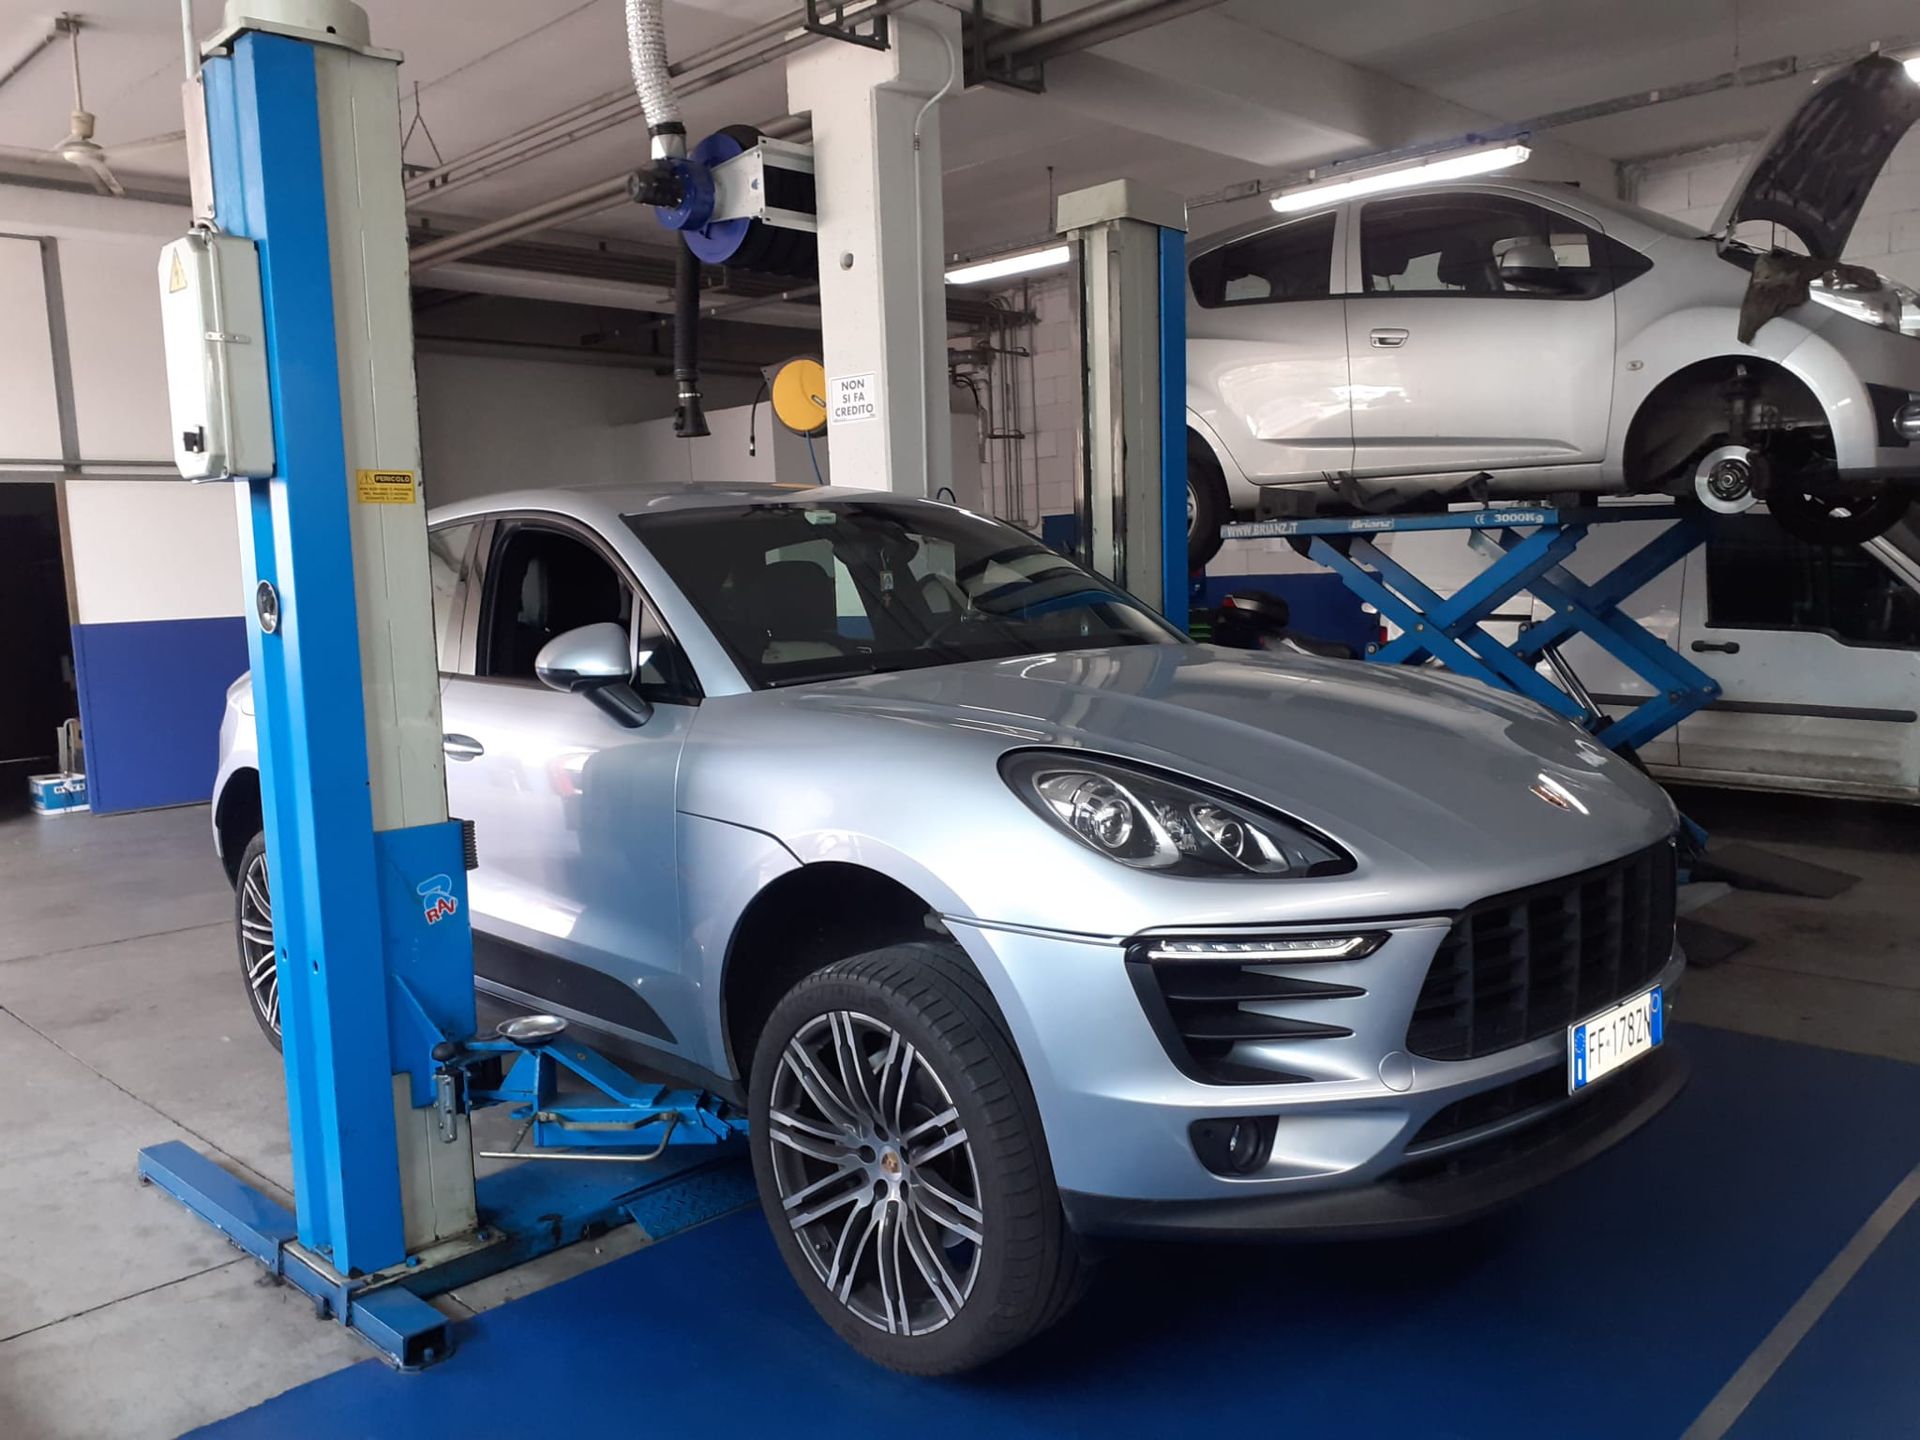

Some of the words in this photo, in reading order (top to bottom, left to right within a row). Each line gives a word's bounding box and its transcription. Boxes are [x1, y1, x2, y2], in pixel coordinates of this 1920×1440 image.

[841, 379, 865, 391] NON
[842, 394, 851, 404] SI
[853, 392, 865, 402] FA
[835, 403, 874, 417] CREDITO
[375, 475, 410, 483] PERICOLO
[1494, 512, 1545, 524] 3000Kg
[425, 897, 456, 925] RAV
